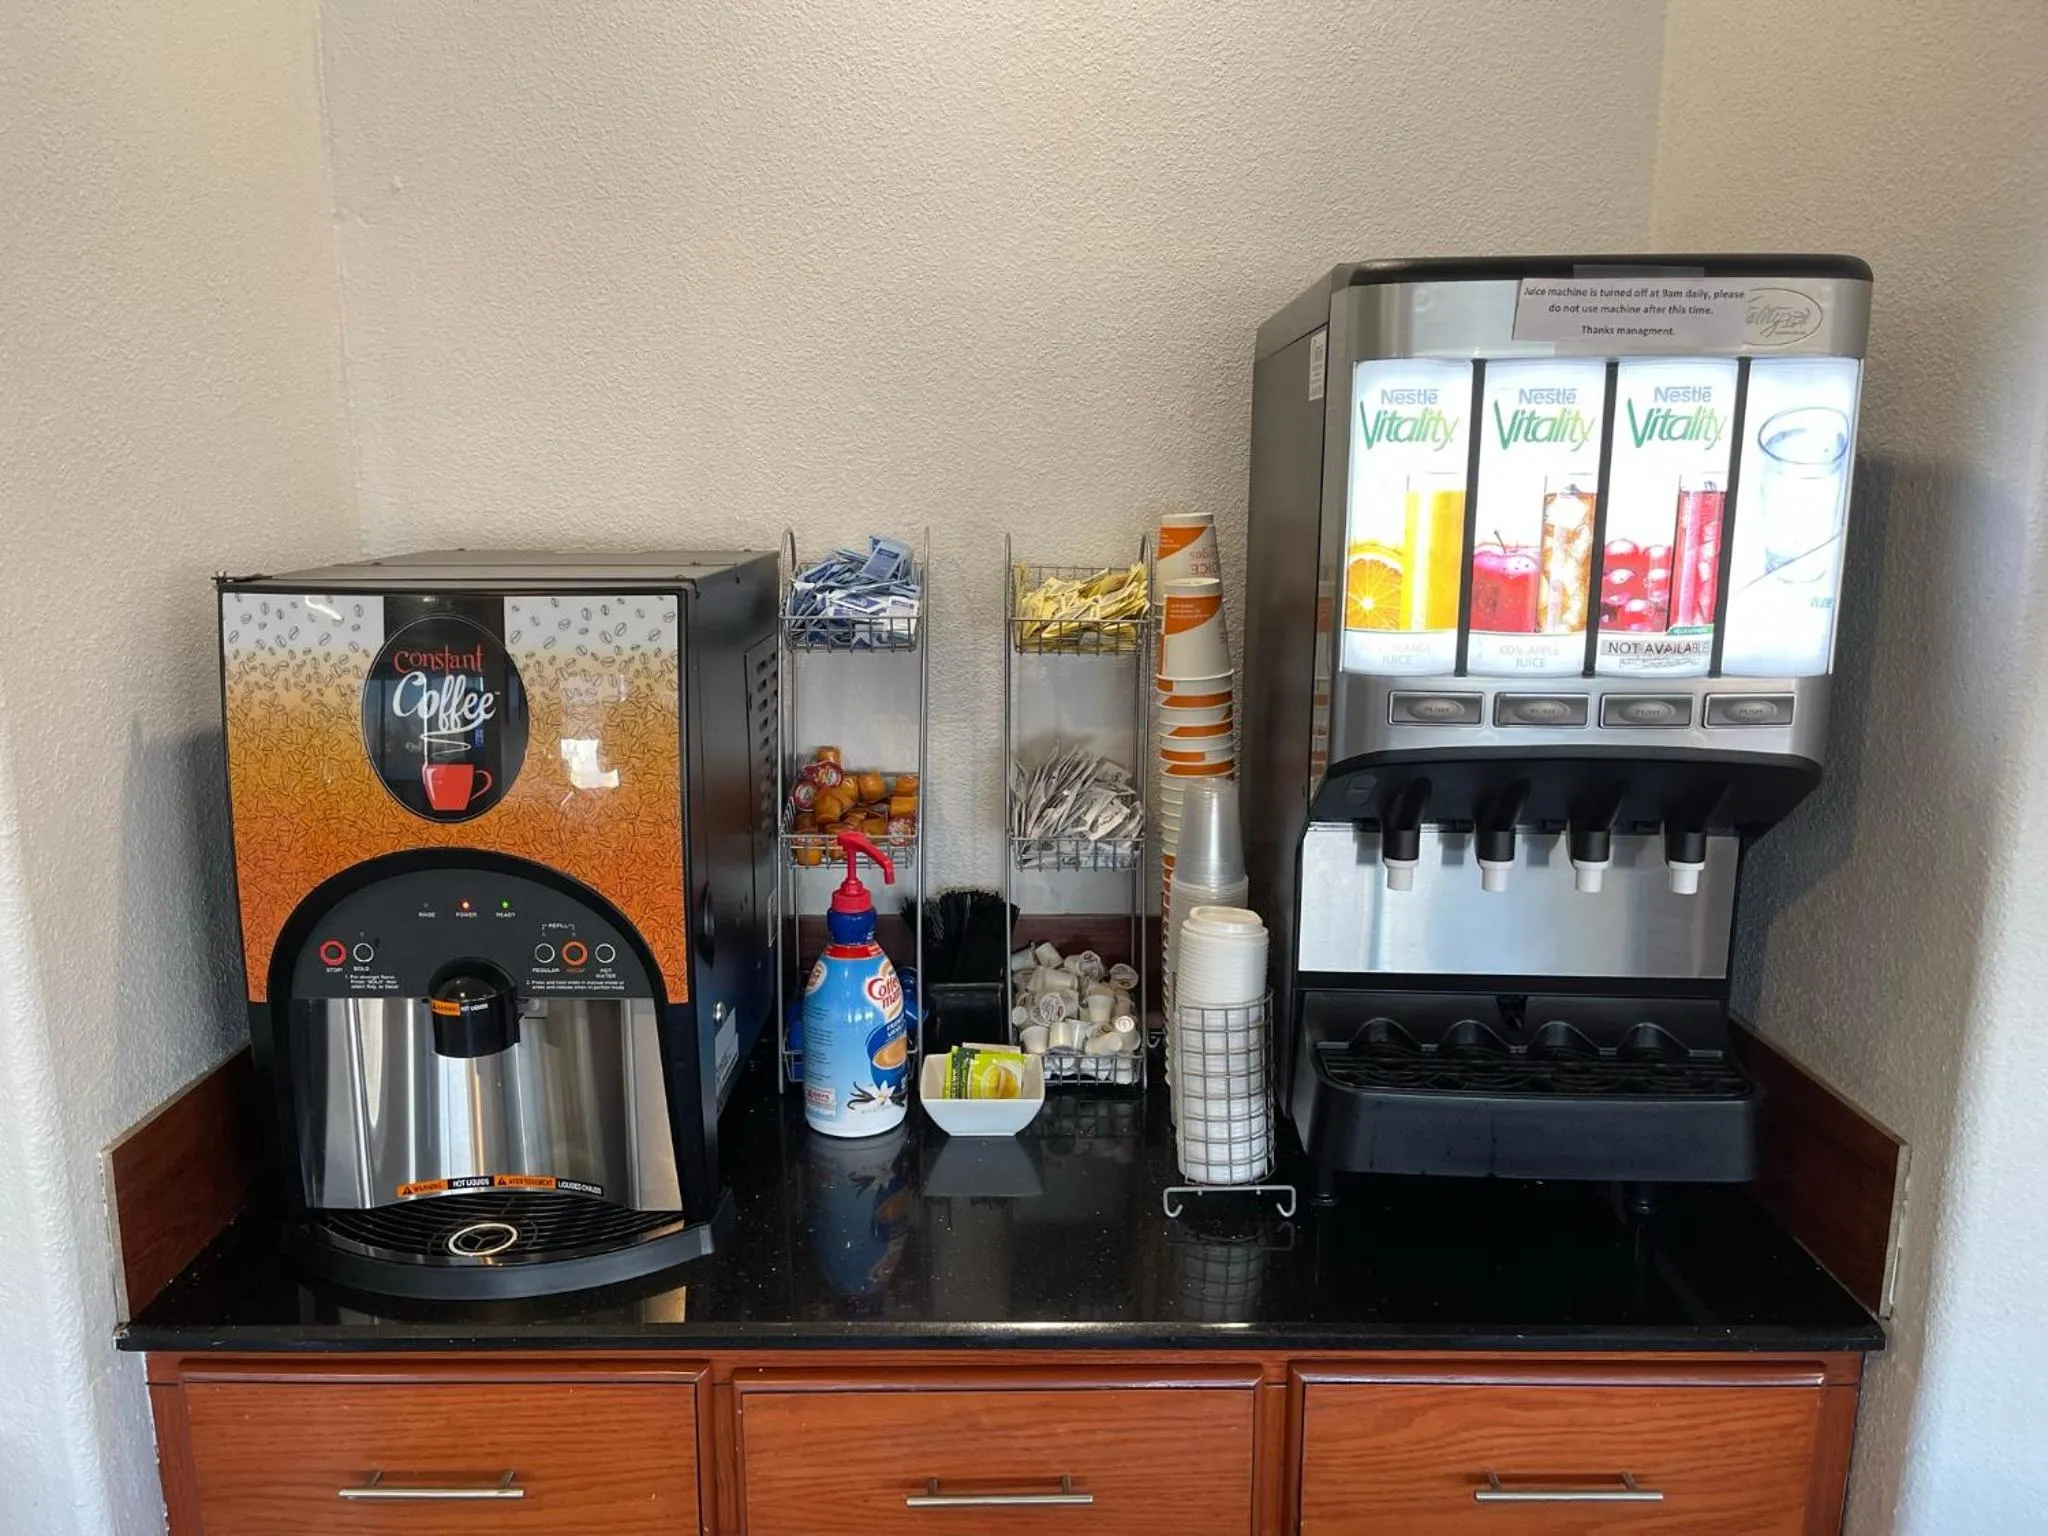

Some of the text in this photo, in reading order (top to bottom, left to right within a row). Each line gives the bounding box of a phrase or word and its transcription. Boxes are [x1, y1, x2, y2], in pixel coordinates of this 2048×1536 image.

[1524, 287, 1744, 300] Juice machine is turned off at 9am daily, please
[1548, 304, 1713, 315] do not use machine after this time.
[1582, 325, 1676, 337] Thanks managment.
[1360, 400, 1460, 452] Vitality
[1493, 399, 1596, 452] Vitality
[1626, 397, 1728, 450] Vitality
[1608, 641, 1638, 655] NOT
[1515, 656, 1546, 668] JUICE
[392, 671, 497, 732] Coffee
[452, 1179, 466, 1188] HOT
